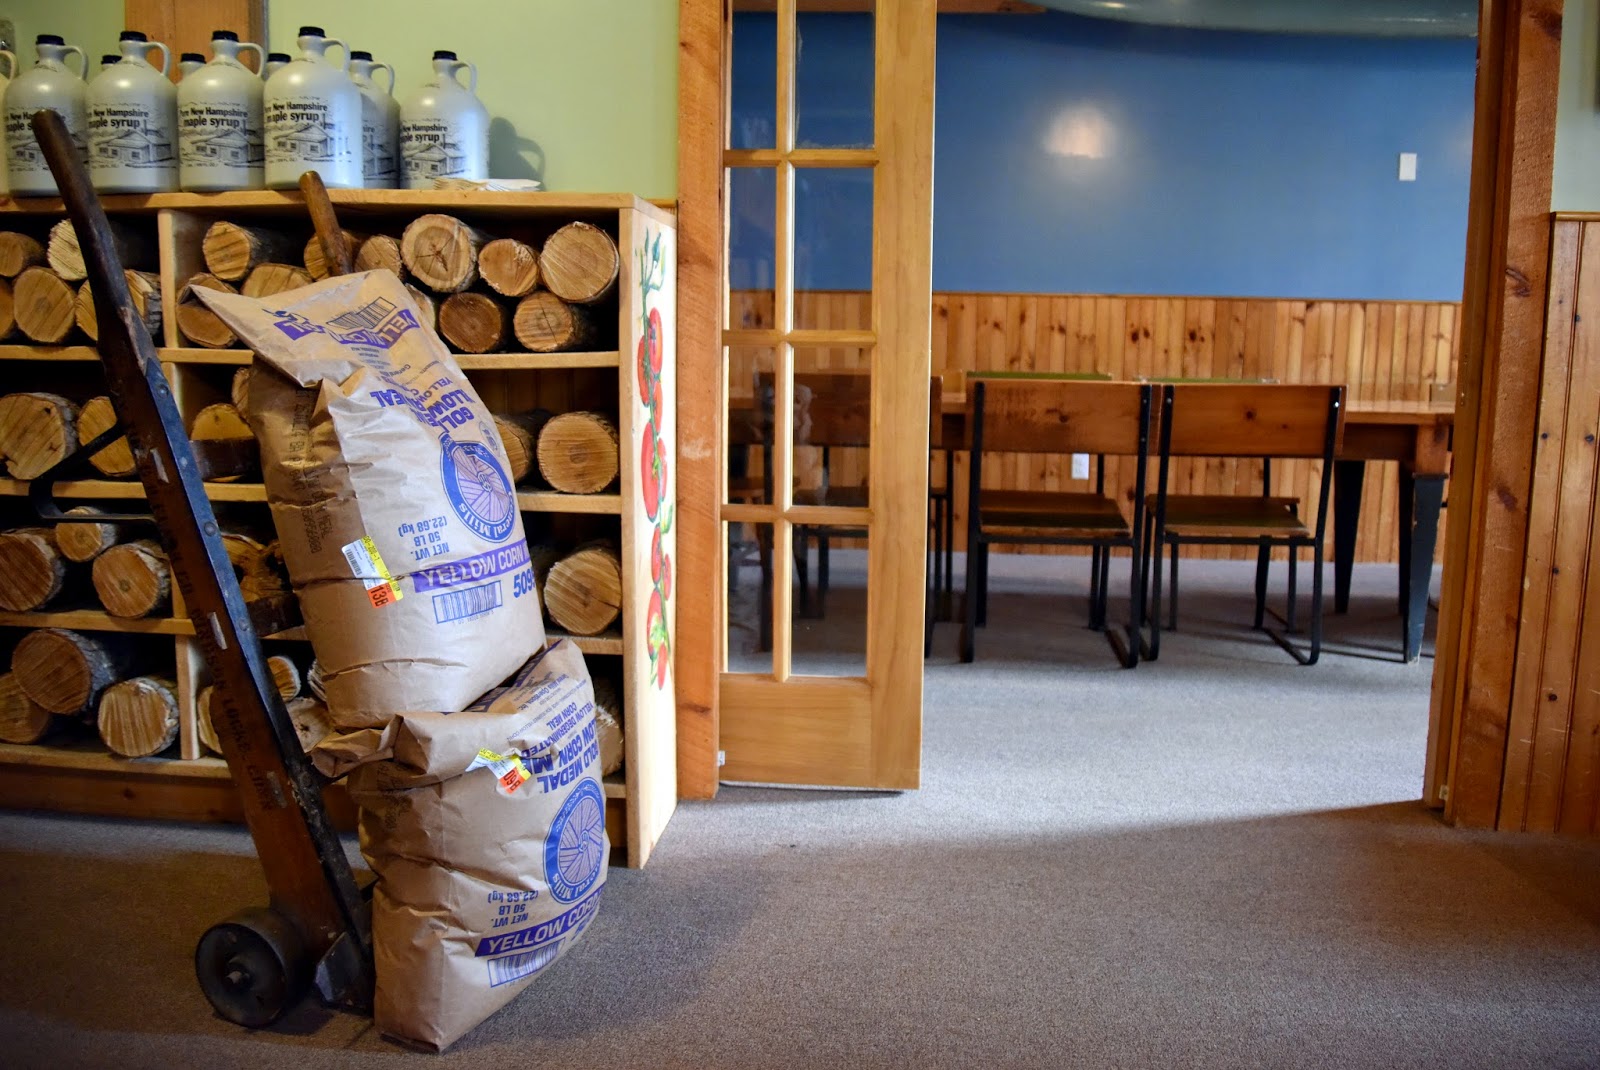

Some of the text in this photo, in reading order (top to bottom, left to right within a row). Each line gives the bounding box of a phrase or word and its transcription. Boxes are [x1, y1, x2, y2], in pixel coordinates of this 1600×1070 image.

[93, 106, 105, 117] New
[106, 107, 149, 118] Hampshire
[190, 107, 204, 116] New
[205, 106, 249, 118] Hampshire
[273, 103, 285, 111] New
[286, 101, 329, 112] Hampshire
[110, 117, 141, 129] syrup
[210, 116, 240, 129] syrup
[290, 111, 320, 124] syrup
[411, 123, 448, 134] Hampshire
[414, 133, 440, 143] syrup
[397, 515, 448, 538] (22.68 kg)
[459, 503, 491, 537] Mills
[413, 531, 441, 548] 50 LB
[410, 541, 450, 561] NET WT.
[420, 553, 496, 588] YELLOW
[498, 544, 525, 571] CORN
[370, 585, 390, 607] 13B
[561, 701, 578, 720] CORN
[575, 700, 595, 721] YELLOW
[545, 713, 563, 732] MEAL
[558, 734, 583, 768] CORN
[503, 769, 522, 792] 09B
[536, 756, 584, 794] MEDAL
[487, 890, 504, 904] kg)
[498, 903, 526, 916] 50 LB
[490, 912, 529, 929] NET WT.
[488, 915, 566, 954] YELLOW
